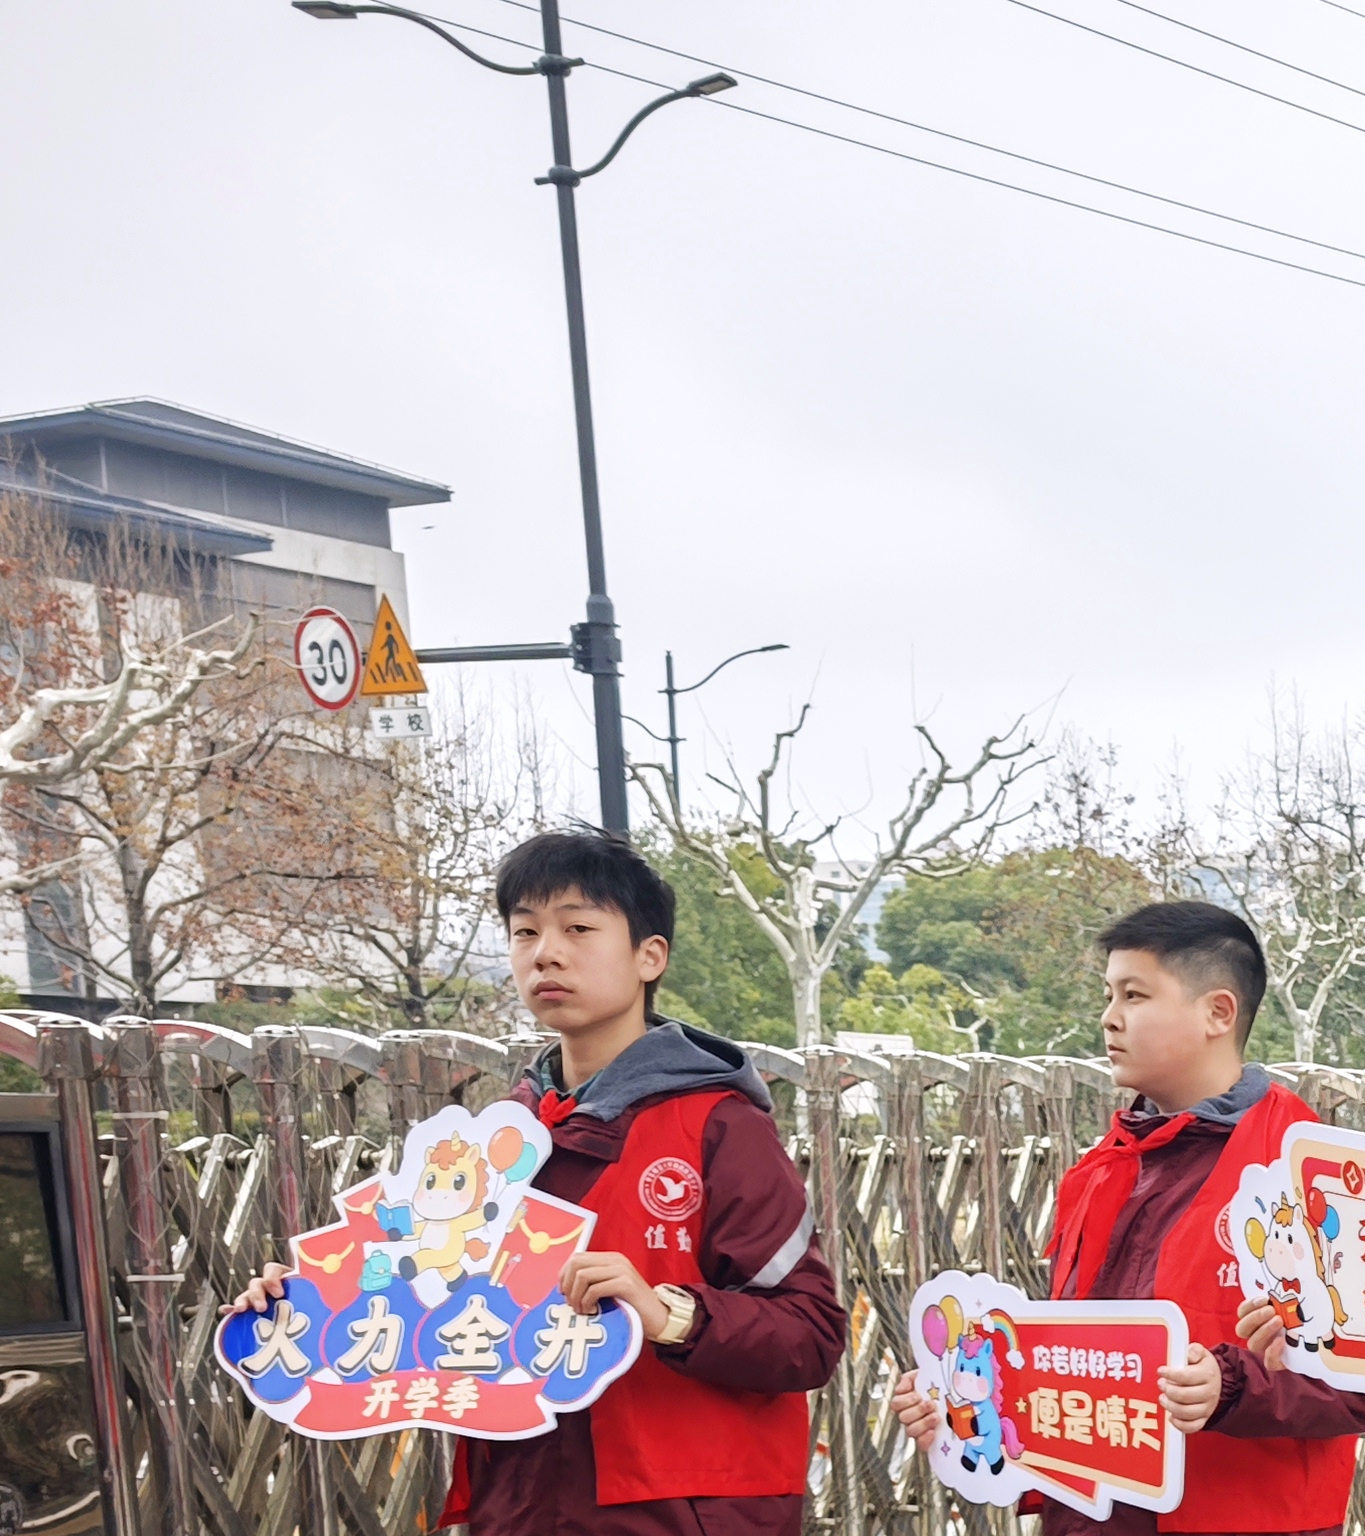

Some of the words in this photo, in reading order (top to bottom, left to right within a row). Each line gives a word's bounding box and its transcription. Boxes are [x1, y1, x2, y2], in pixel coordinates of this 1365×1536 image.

[308, 639, 347, 686] 30
[379, 714, 424, 733] 学校
[239, 1298, 604, 1374] 火力全开
[1032, 1345, 1143, 1383] 你若好好学习
[362, 1378, 480, 1419] 开学季
[1028, 1387, 1161, 1451] 便是晴天
